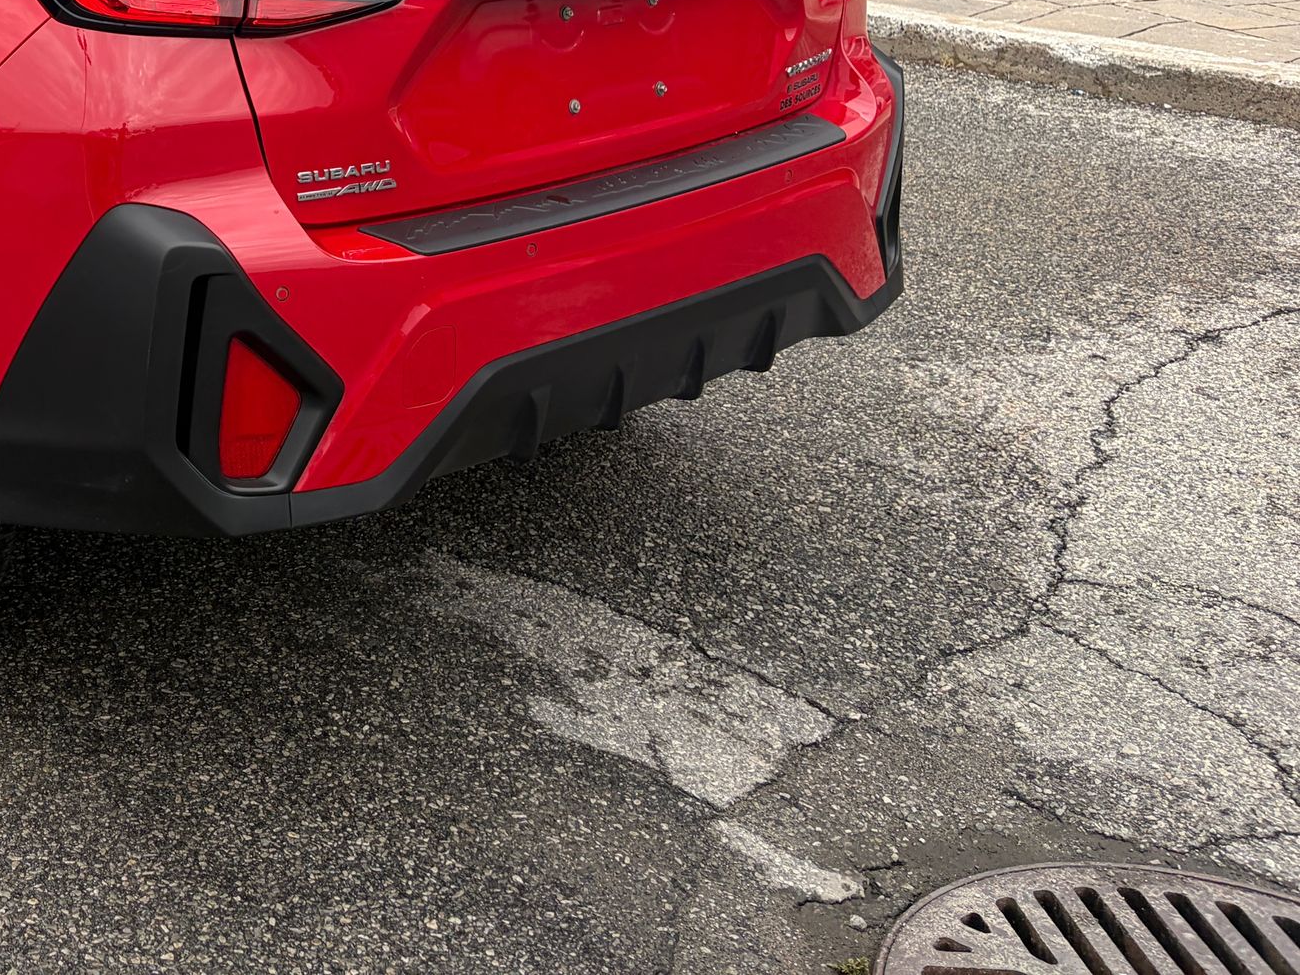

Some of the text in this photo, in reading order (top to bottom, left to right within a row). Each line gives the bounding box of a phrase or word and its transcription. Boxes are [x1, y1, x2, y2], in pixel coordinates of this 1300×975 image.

[793, 73, 819, 91] SUBARU
[780, 83, 821, 112] DES SOURCES
[297, 160, 390, 183] SUBARU
[336, 178, 397, 196] AWD
